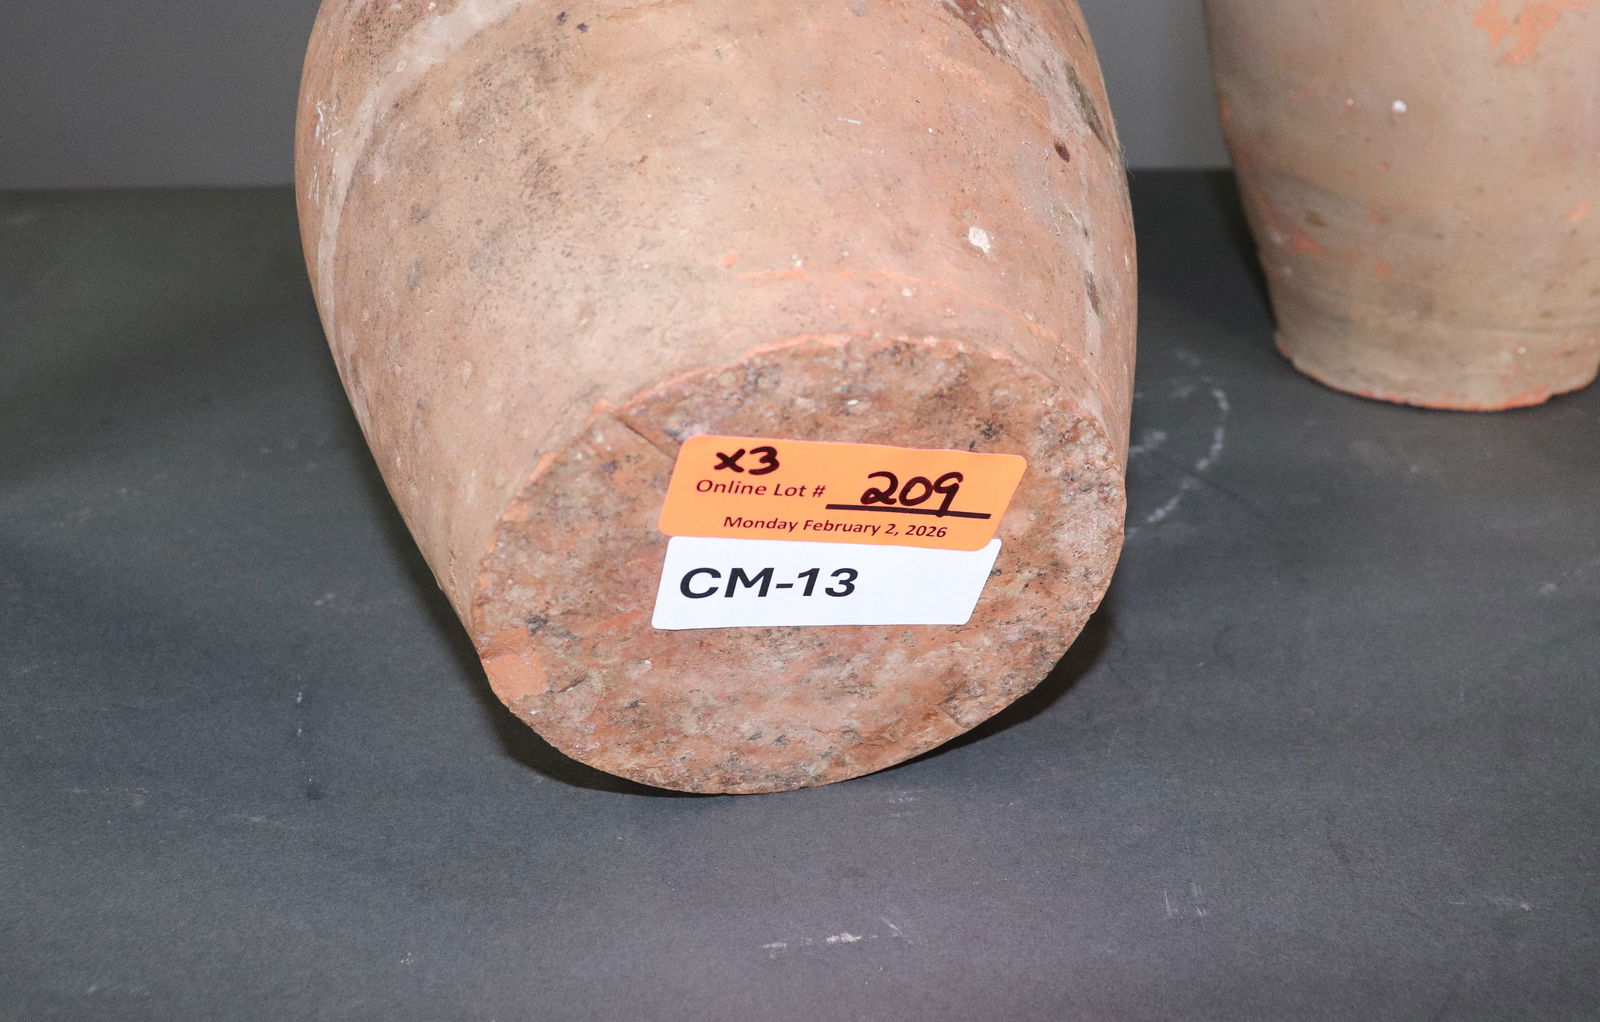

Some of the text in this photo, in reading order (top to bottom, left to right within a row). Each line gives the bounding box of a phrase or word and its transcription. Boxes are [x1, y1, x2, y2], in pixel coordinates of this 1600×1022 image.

[696, 471, 964, 518] Online Lot # 209
[723, 516, 948, 538] Monday February 2, 2026
[679, 567, 859, 599] CM-13
